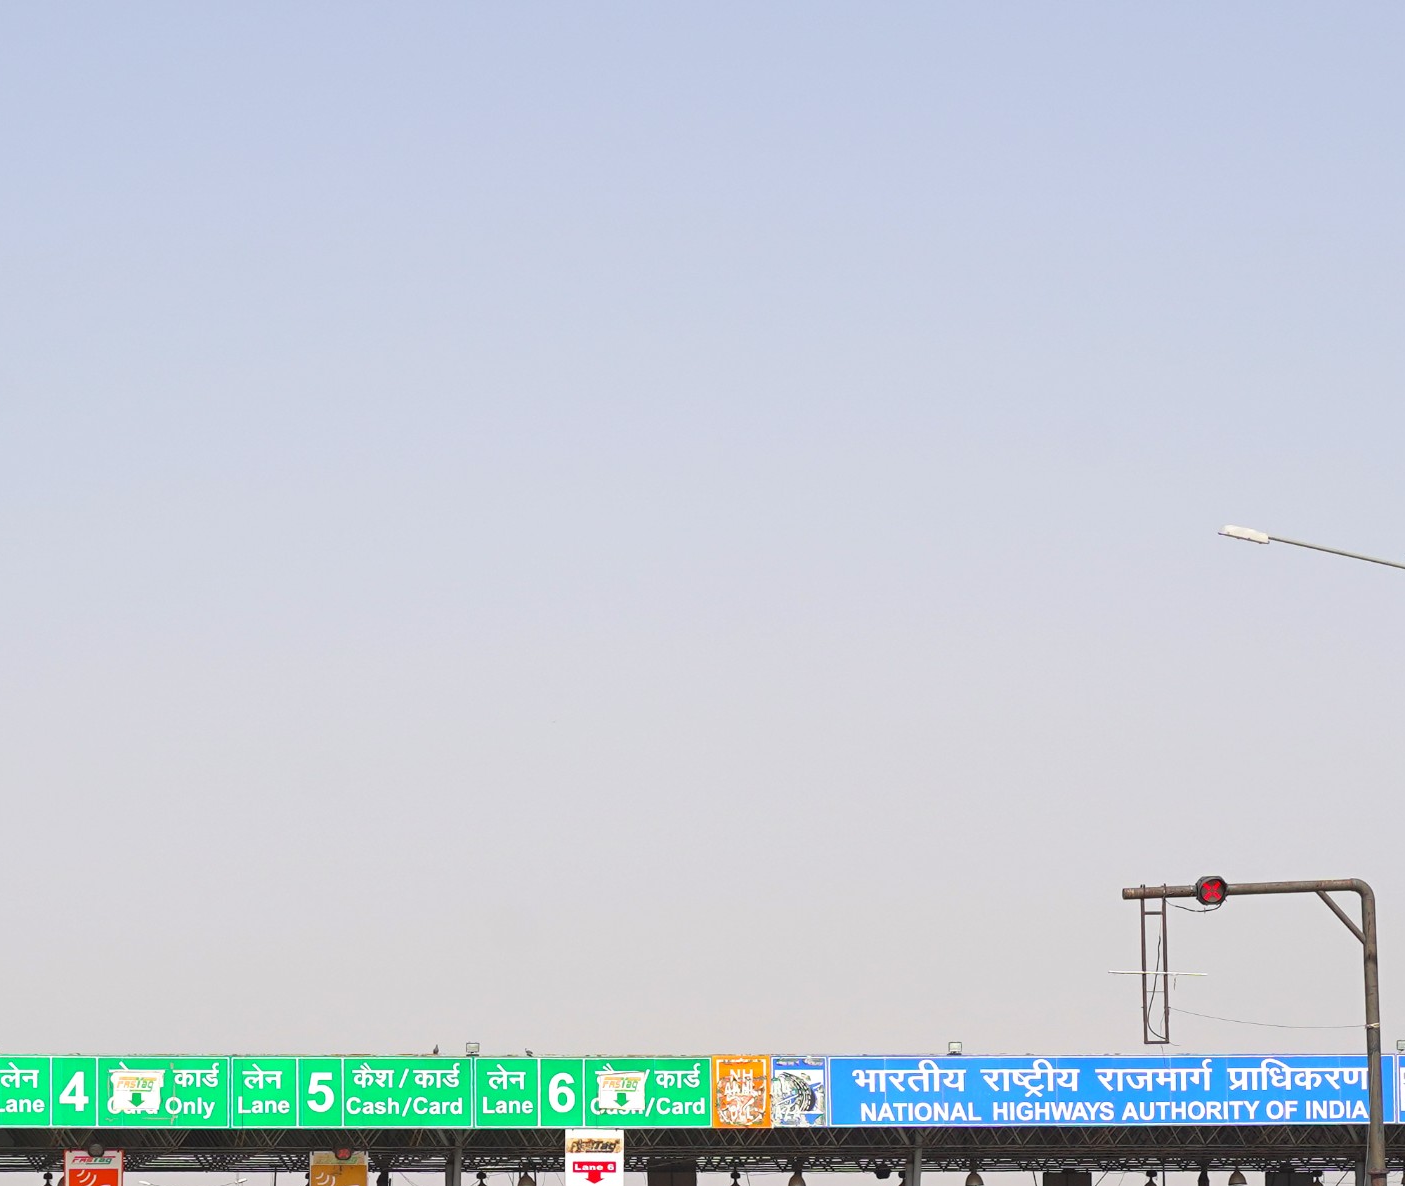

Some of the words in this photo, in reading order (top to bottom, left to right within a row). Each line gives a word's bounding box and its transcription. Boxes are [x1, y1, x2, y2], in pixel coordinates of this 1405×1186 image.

[173, 1063, 219, 1087] कार्ड
[242, 1063, 282, 1089] लेन
[352, 1063, 394, 1088] कैश
[413, 1063, 460, 1088] कार्ड
[487, 1064, 526, 1090] लेन
[654, 1063, 700, 1088] कार्ड
[852, 1060, 966, 1093] भारतीय
[980, 1059, 1080, 1097] राष्ट्रीय
[1097, 1059, 1212, 1092] राजमार्ग
[1227, 1058, 1368, 1091] प्राधिकरण
[59, 1071, 89, 1112] 4
[307, 1072, 335, 1112] 5
[549, 1072, 575, 1112] 6
[165, 1097, 215, 1119] Only
[238, 1097, 290, 1114] Lane
[346, 1097, 462, 1117] Cash/Card
[483, 1097, 533, 1114] Lane
[861, 1103, 981, 1121] NATIONAL
[993, 1101, 1115, 1121] HIGHWAYS
[1122, 1101, 1260, 1121] AUTHORITY
[1266, 1101, 1297, 1120] OF
[1305, 1101, 1369, 1119] INDIA
